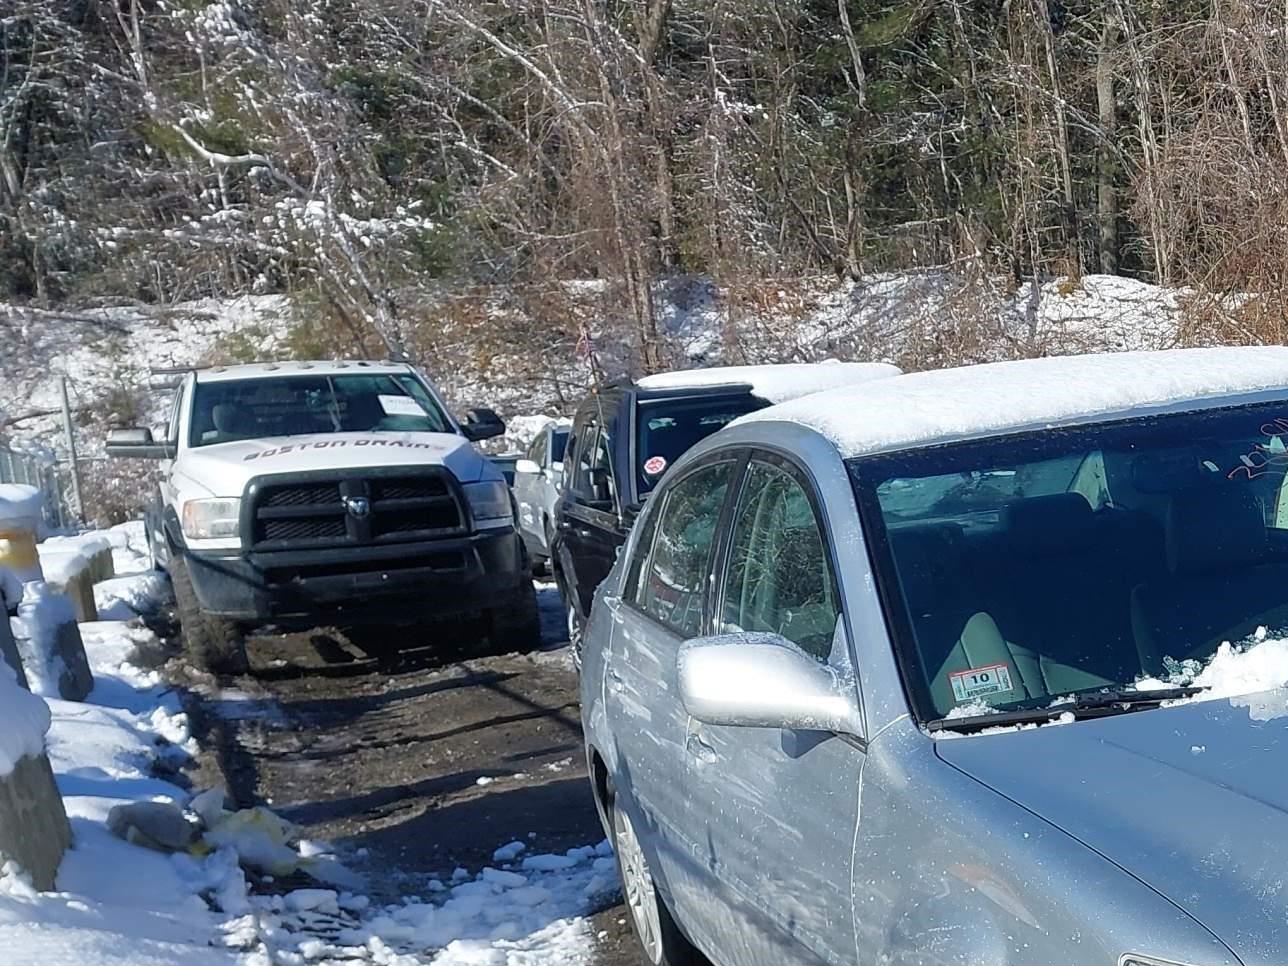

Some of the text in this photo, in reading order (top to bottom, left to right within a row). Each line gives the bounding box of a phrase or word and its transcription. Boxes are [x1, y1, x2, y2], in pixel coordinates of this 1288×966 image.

[243, 439, 430, 461] BOSTON DRAIN
[971, 673, 990, 684] 10
